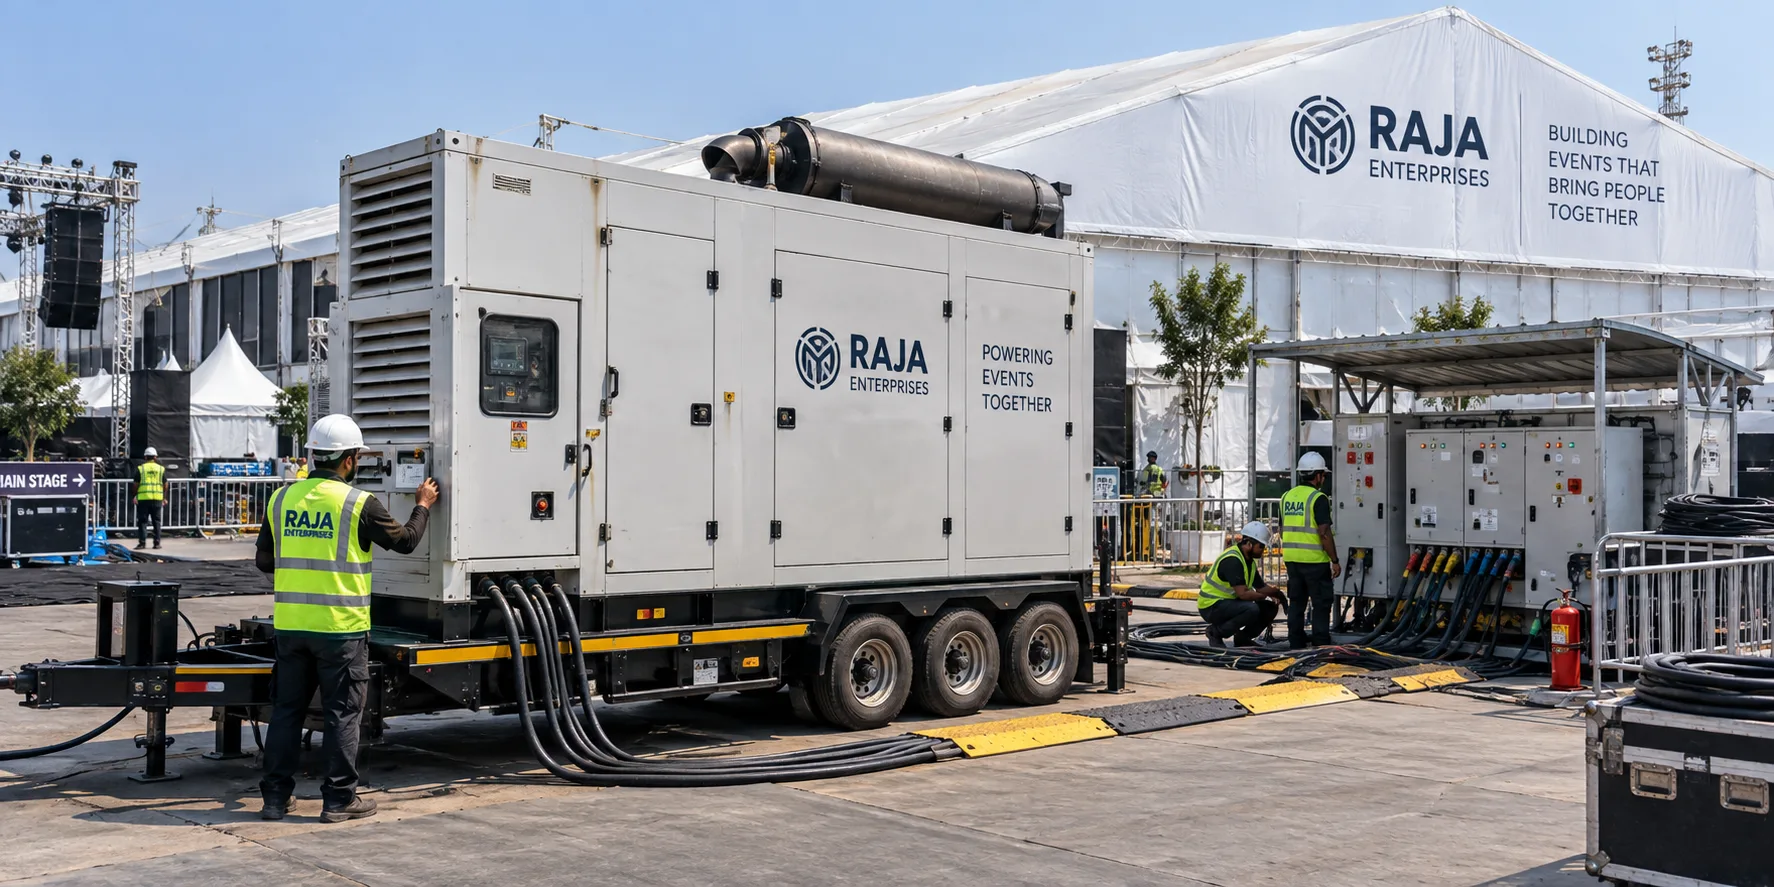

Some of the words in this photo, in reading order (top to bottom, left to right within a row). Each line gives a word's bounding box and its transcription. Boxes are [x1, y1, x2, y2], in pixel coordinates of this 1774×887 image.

[1370, 105, 1489, 160] RAJA
[1549, 124, 1628, 148] BUILDING
[1369, 159, 1490, 187] ENTERPRISES
[1549, 150, 1612, 172] EVENTS
[1617, 157, 1659, 177] THAT
[1549, 177, 1599, 197] BRING
[1605, 182, 1665, 203] PEOPLE
[1548, 202, 1638, 226] TOGETHER
[850, 333, 928, 374] RAJA
[982, 344, 1053, 365] POWERING
[850, 376, 929, 395] ENTERPRISES
[982, 369, 1034, 387] EVENTS
[982, 393, 1052, 412] TOGETHER
[28, 474, 68, 488] STAGE
[1285, 501, 1304, 511] RAJA
[285, 509, 334, 530] RAJA
